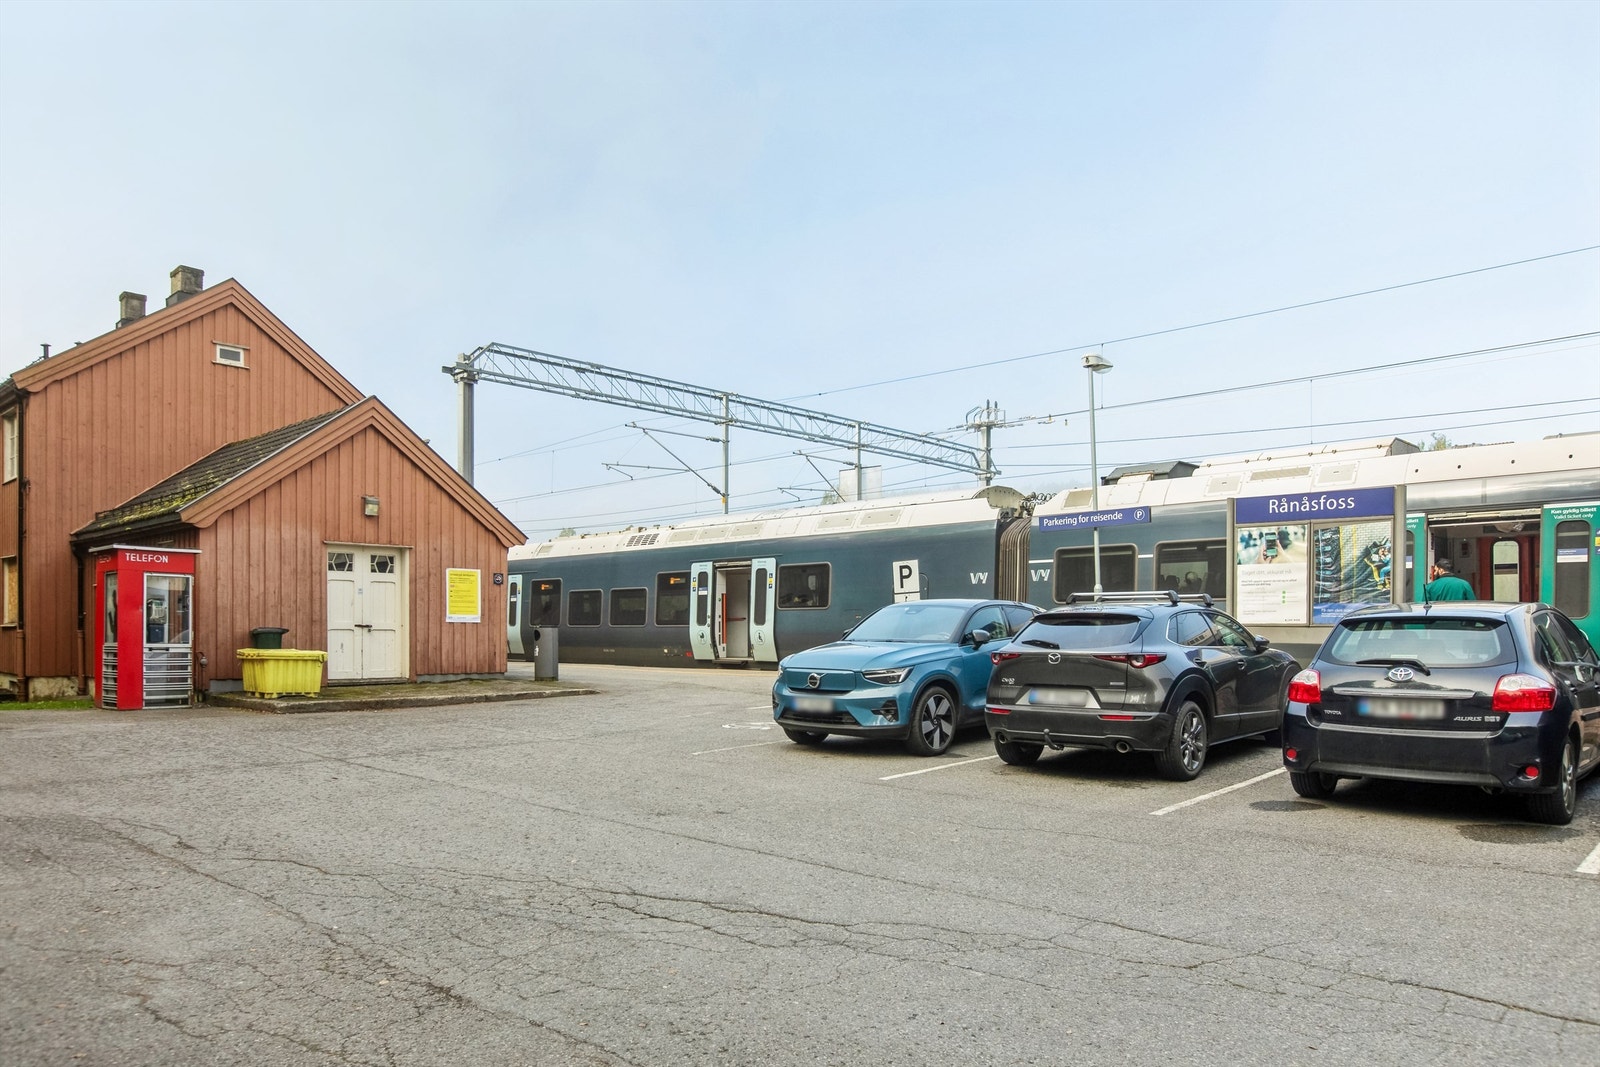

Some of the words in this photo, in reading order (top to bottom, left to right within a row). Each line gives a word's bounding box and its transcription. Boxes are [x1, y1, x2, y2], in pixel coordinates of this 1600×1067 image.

[1269, 495, 1355, 513] Rånåsfoss
[1043, 516, 1077, 527] Parkering
[1078, 515, 1089, 523] for
[1090, 511, 1123, 522] reisende
[125, 553, 169, 563] TELEFON
[899, 564, 913, 589] P
